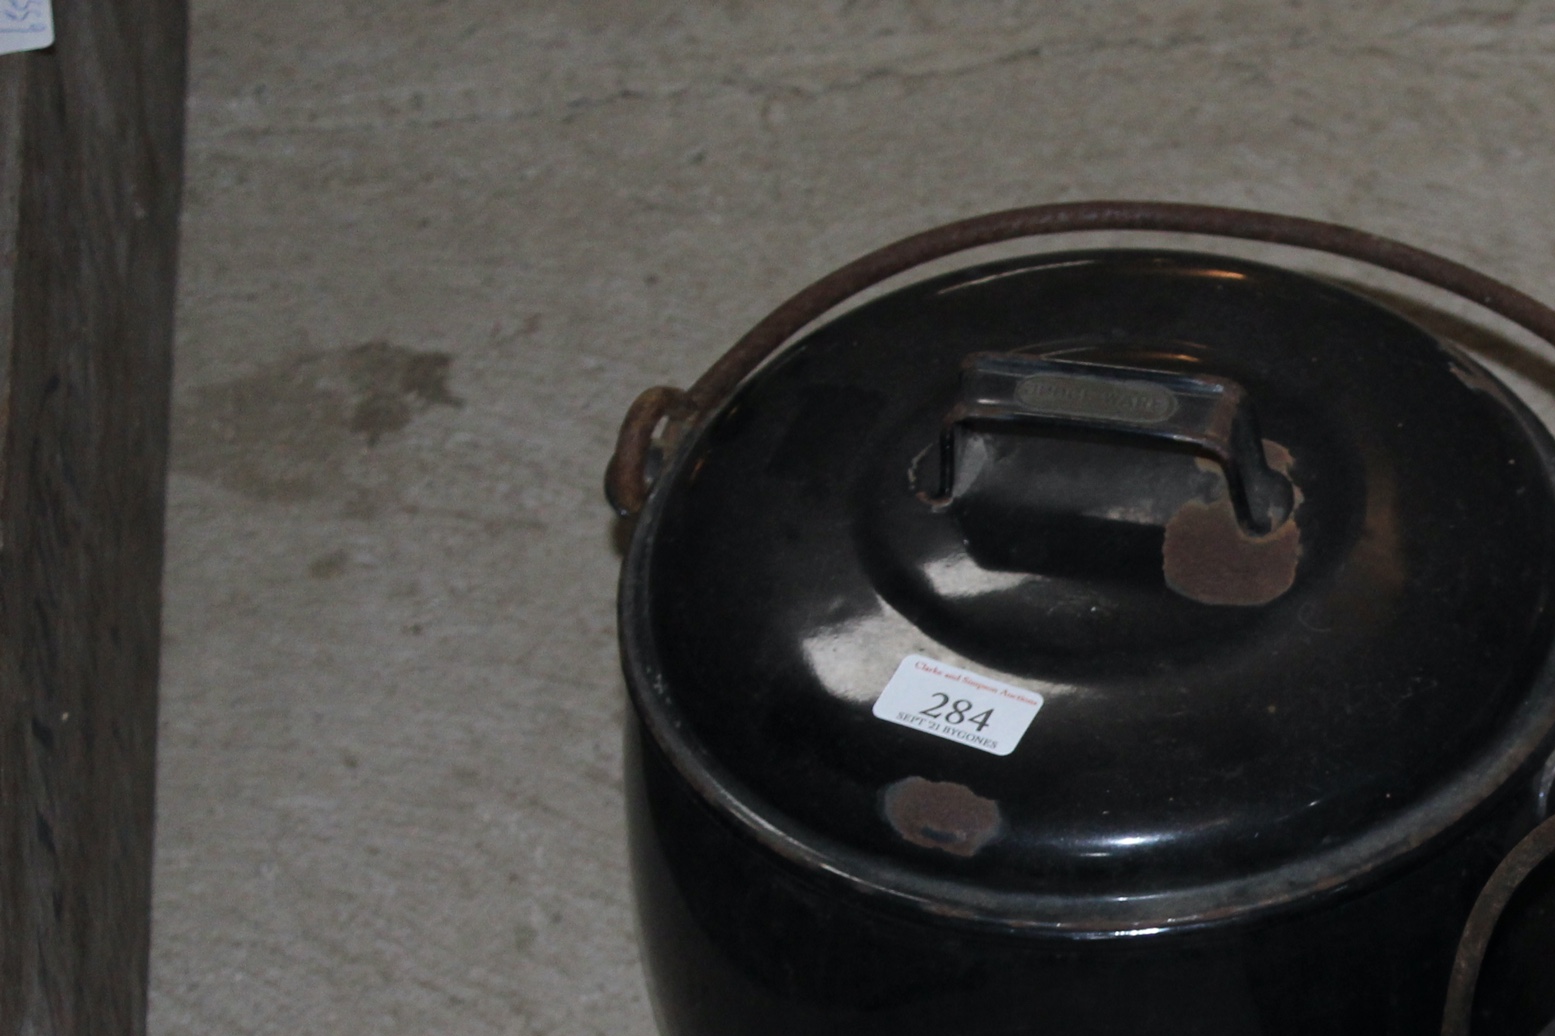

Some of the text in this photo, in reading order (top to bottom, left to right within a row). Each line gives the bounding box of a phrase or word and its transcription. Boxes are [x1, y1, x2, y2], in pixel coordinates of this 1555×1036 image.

[914, 661, 1037, 706] Clarke and Simpson Auctions
[896, 711, 926, 727] SEPT
[943, 726, 998, 749] BYGONES
[919, 692, 995, 732] 284
